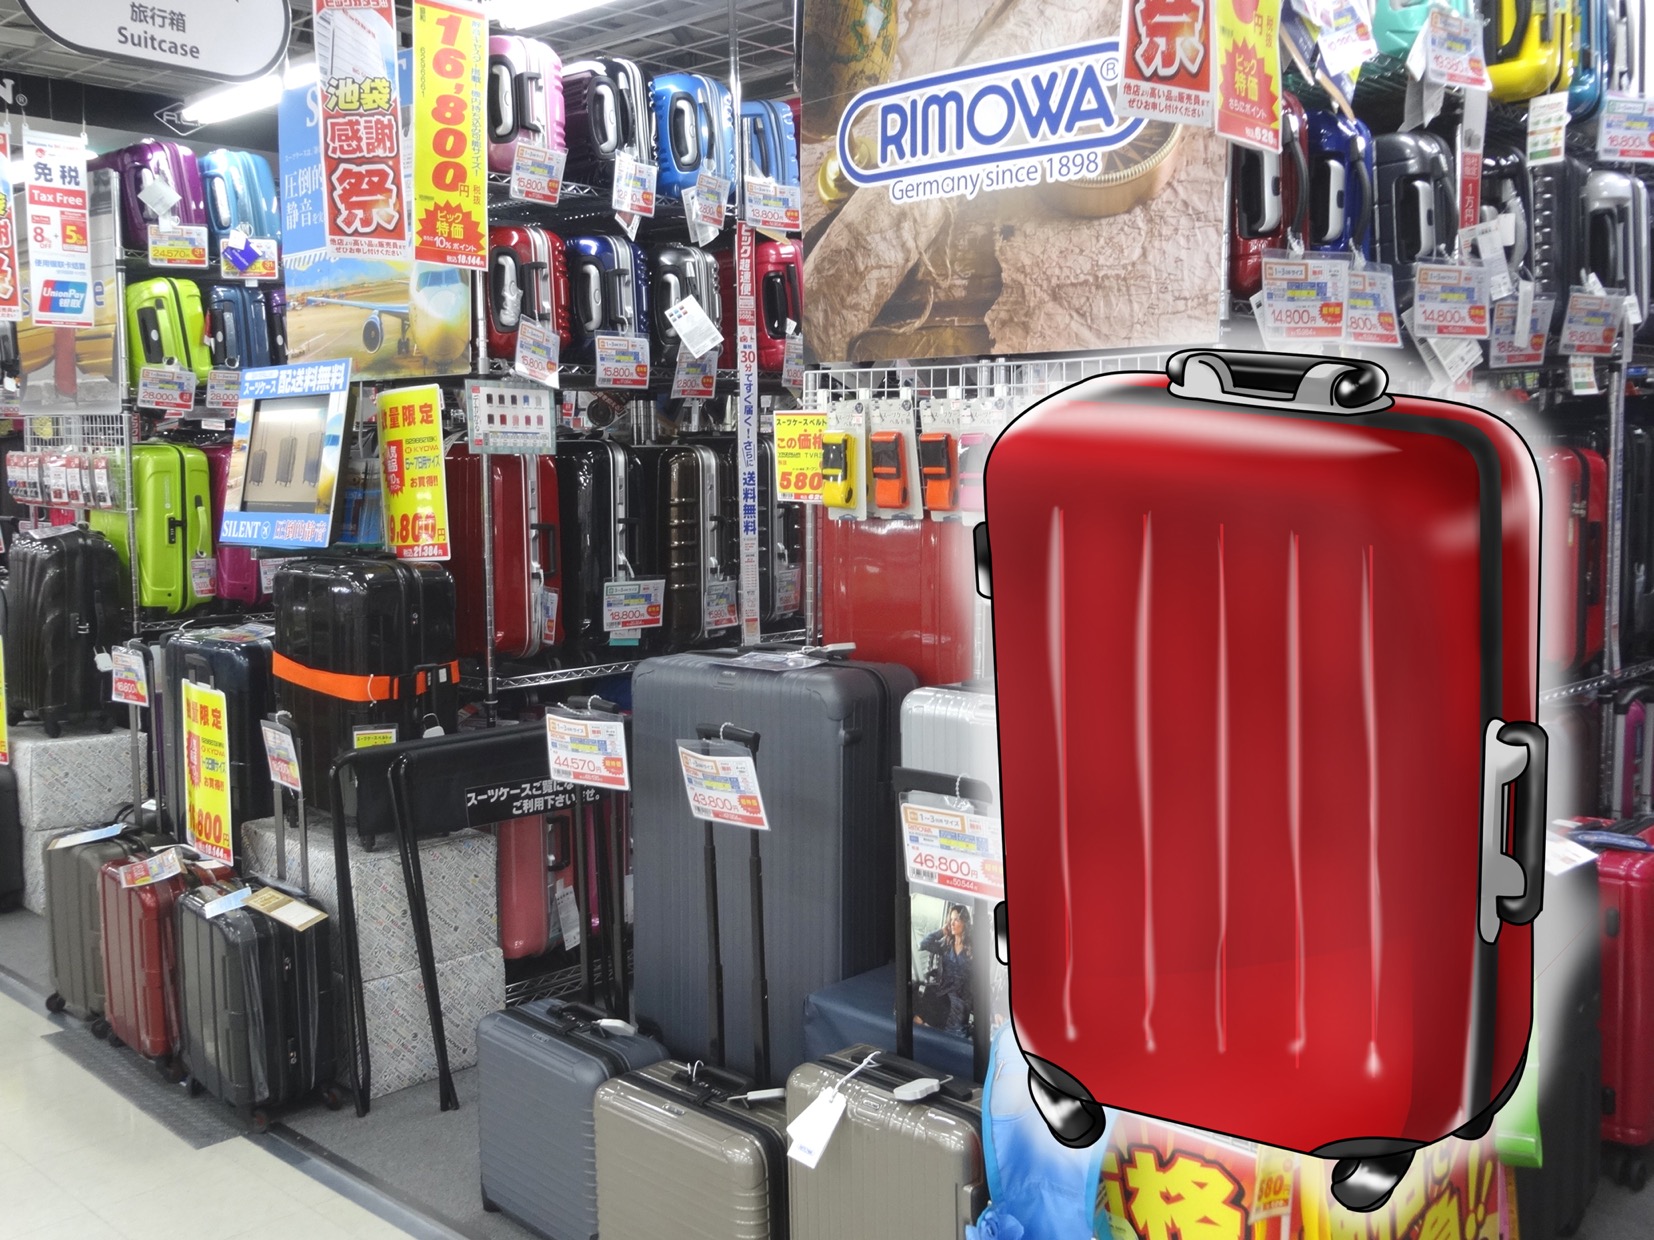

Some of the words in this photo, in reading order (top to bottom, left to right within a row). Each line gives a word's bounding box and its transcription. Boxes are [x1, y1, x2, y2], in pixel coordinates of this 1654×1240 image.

[130, 2, 187, 33] 旅行箱
[117, 26, 200, 59] Suitcase
[325, 76, 393, 113] 池袋
[1234, 71, 1259, 102] 特価
[880, 64, 1114, 165] RIMOWA
[327, 115, 399, 160] 感謝
[891, 169, 981, 203] Germany
[984, 164, 1039, 187] since
[1046, 151, 1099, 179] 1898
[32, 190, 54, 203] Tax
[56, 193, 83, 206] Free
[335, 162, 400, 235] 祭
[436, 221, 464, 239] 特価
[42, 287, 84, 300] UnionPay
[1271, 308, 1317, 325] 14,800円
[277, 362, 346, 395] 配送料無料
[414, 444, 439, 452] KYOWA
[222, 520, 261, 538] SILENT
[554, 755, 602, 773] 44,570円
[693, 792, 739, 813] 43,800円
[913, 852, 978, 879] 46,800円
